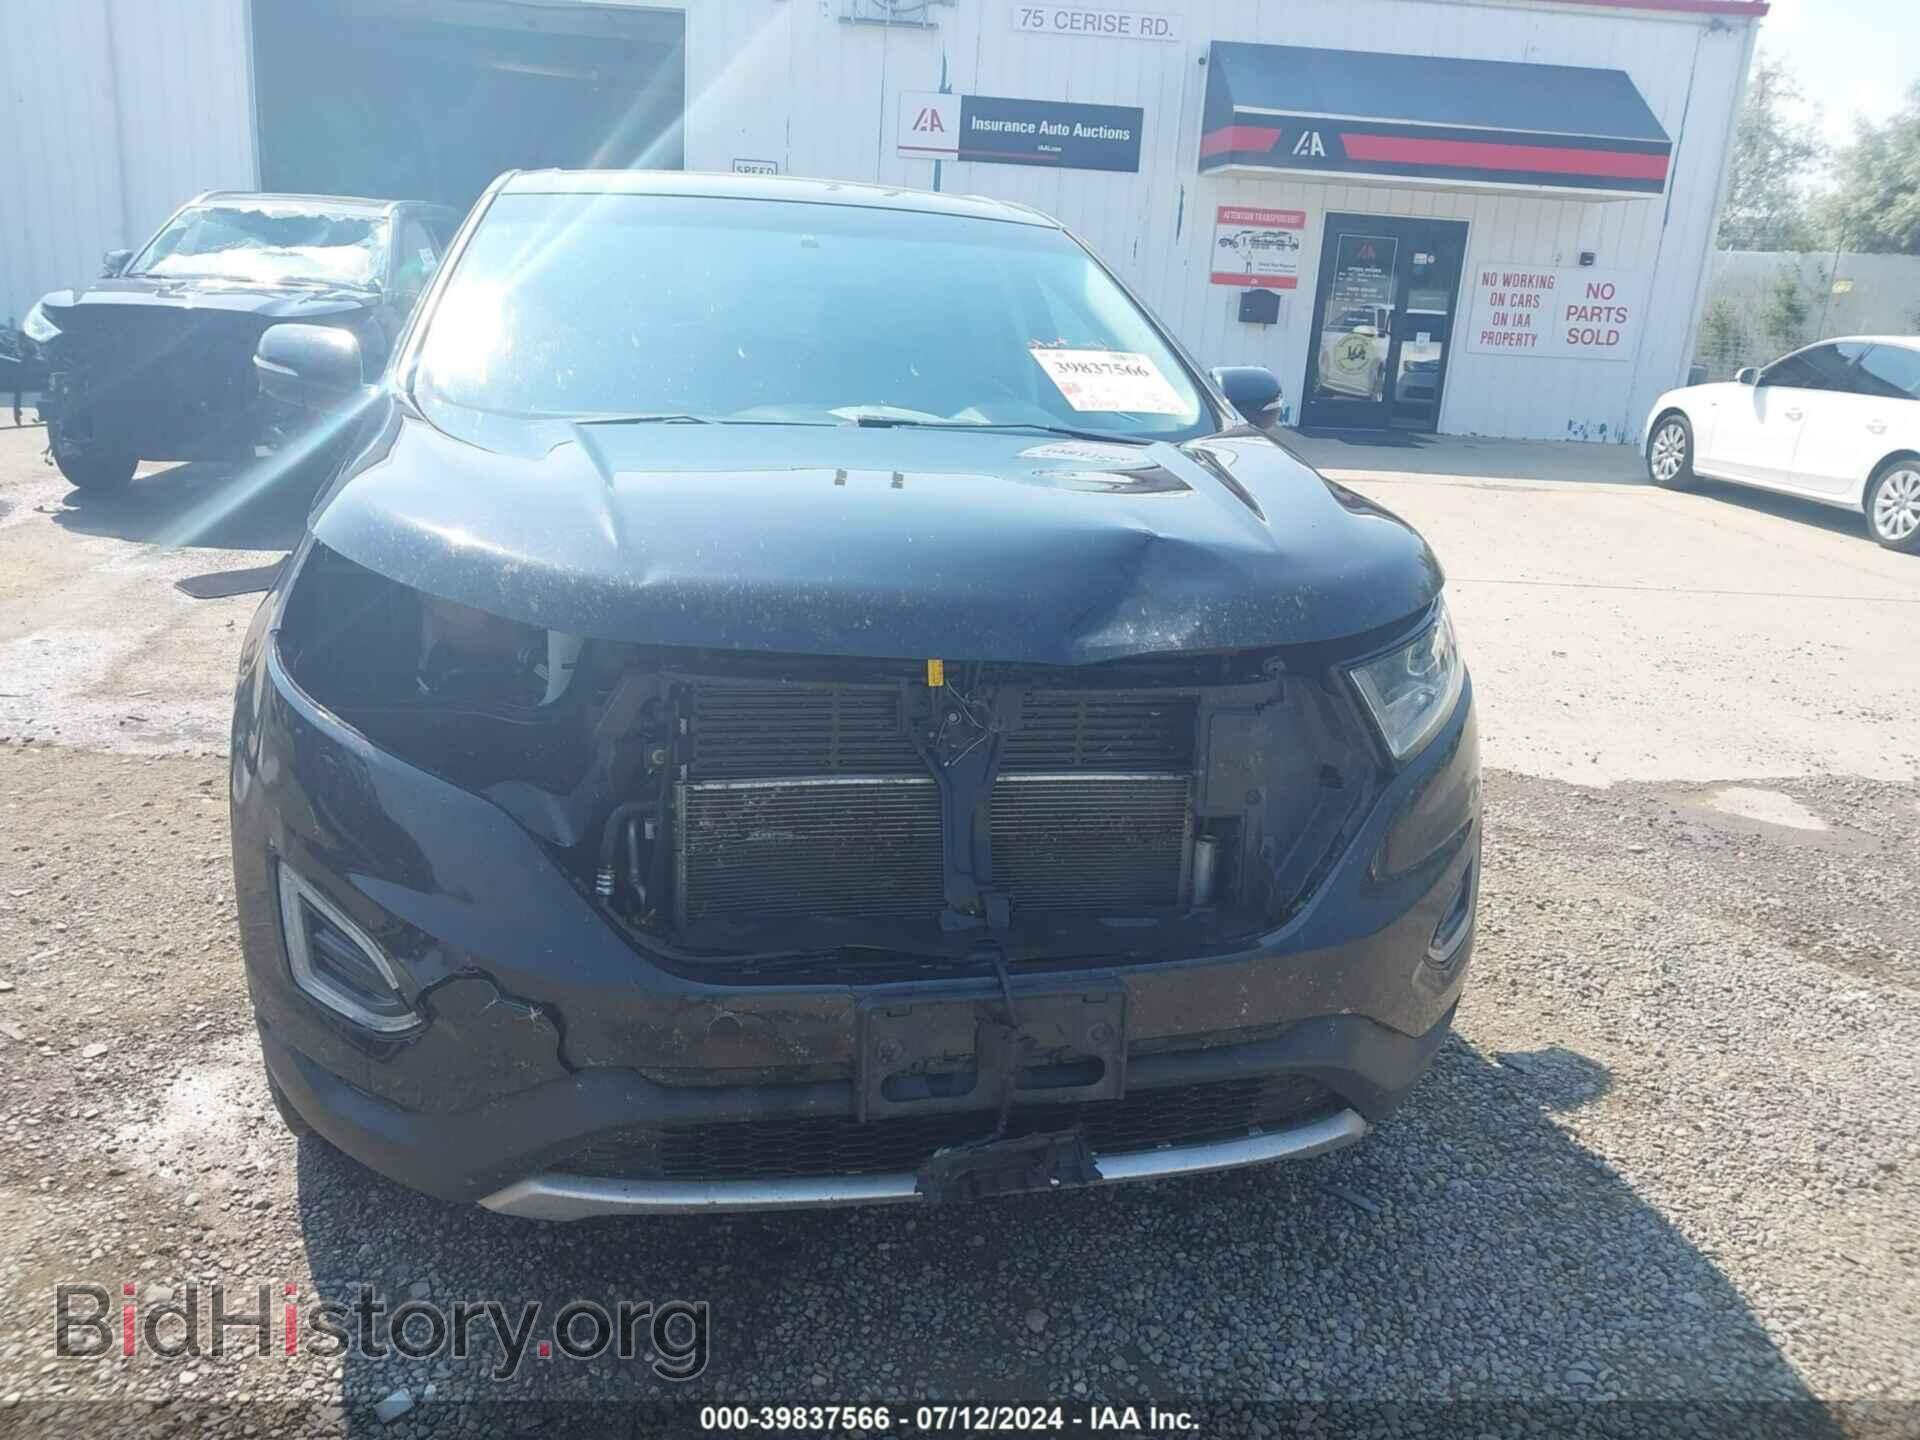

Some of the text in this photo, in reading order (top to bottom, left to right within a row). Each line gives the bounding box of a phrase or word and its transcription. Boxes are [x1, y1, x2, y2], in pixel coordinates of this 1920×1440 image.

[1020, 8, 1174, 37] 75 CERISE RD.
[971, 116, 1131, 141] Insurance Auto Auctions
[1482, 271, 1556, 290] NO WORKING
[1489, 291, 1541, 309] ON CARS
[1586, 282, 1616, 301] NO
[1492, 311, 1532, 328] ON IAA
[1566, 304, 1628, 324] PARTS
[1480, 330, 1538, 348] PROPERTY
[1566, 328, 1620, 347] SOLD
[1054, 361, 1150, 377] 39837566
